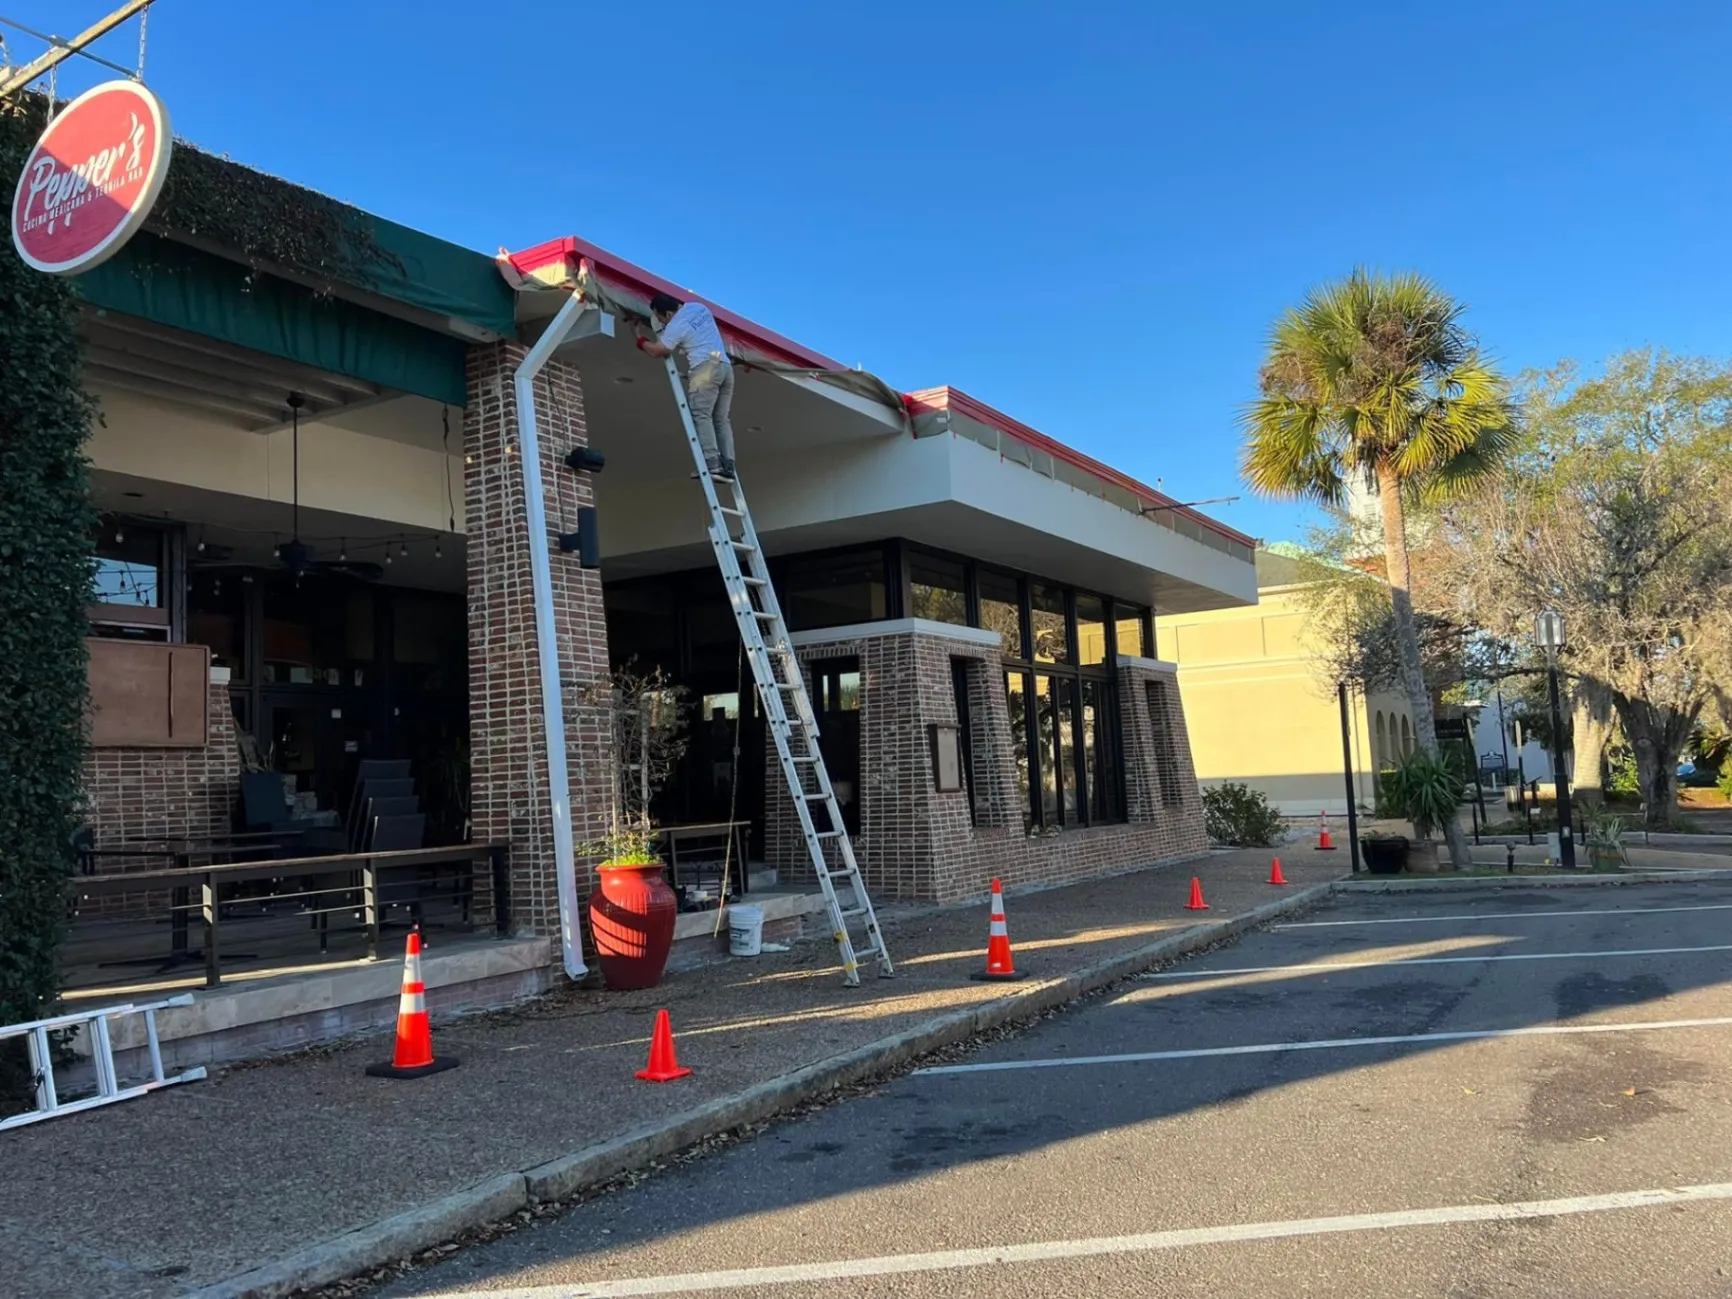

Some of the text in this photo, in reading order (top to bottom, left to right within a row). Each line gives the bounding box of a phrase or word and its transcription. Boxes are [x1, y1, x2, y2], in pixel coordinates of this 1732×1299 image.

[23, 211, 47, 233] COCINA
[49, 195, 85, 219] MEXICANA
[95, 175, 125, 199] TEQUILA
[128, 166, 143, 182] BAR
[24, 112, 146, 235] Pepper's
